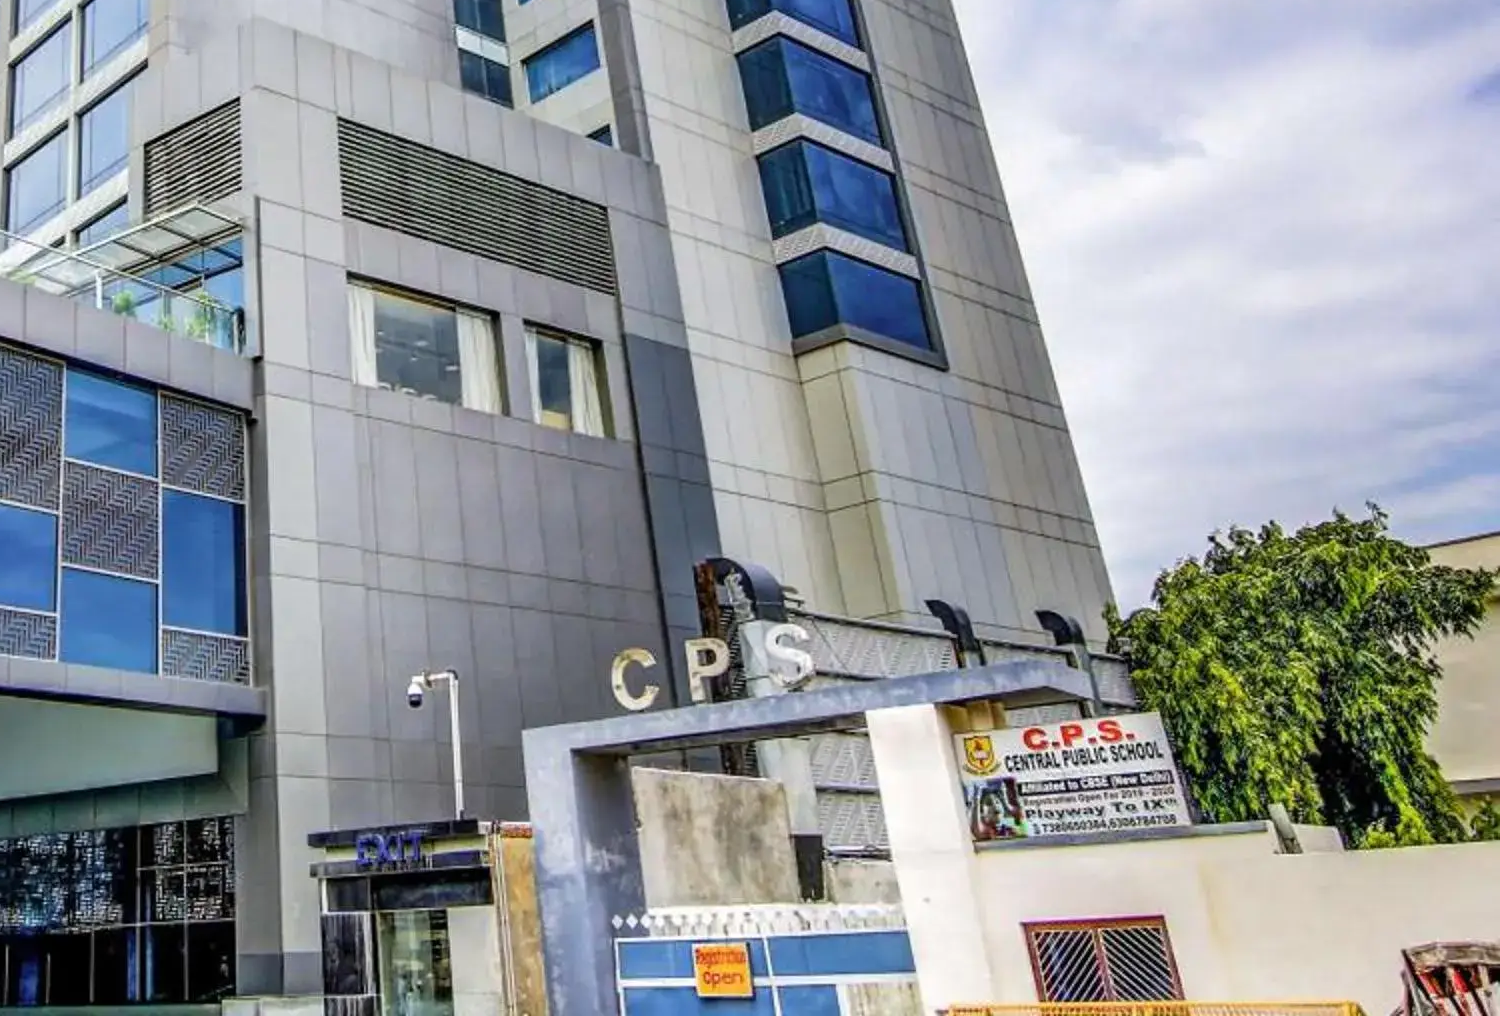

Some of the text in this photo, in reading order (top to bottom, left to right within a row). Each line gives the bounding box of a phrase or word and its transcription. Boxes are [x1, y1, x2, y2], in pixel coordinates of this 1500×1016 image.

[1023, 720, 1135, 750] C.P.S.
[1005, 741, 1164, 772] CENTRAL PUBLIC SCHOOL
[1025, 805, 1104, 820] Playway
[1110, 801, 1137, 813] To
[356, 832, 423, 866] EXIT
[703, 970, 745, 991] Open
